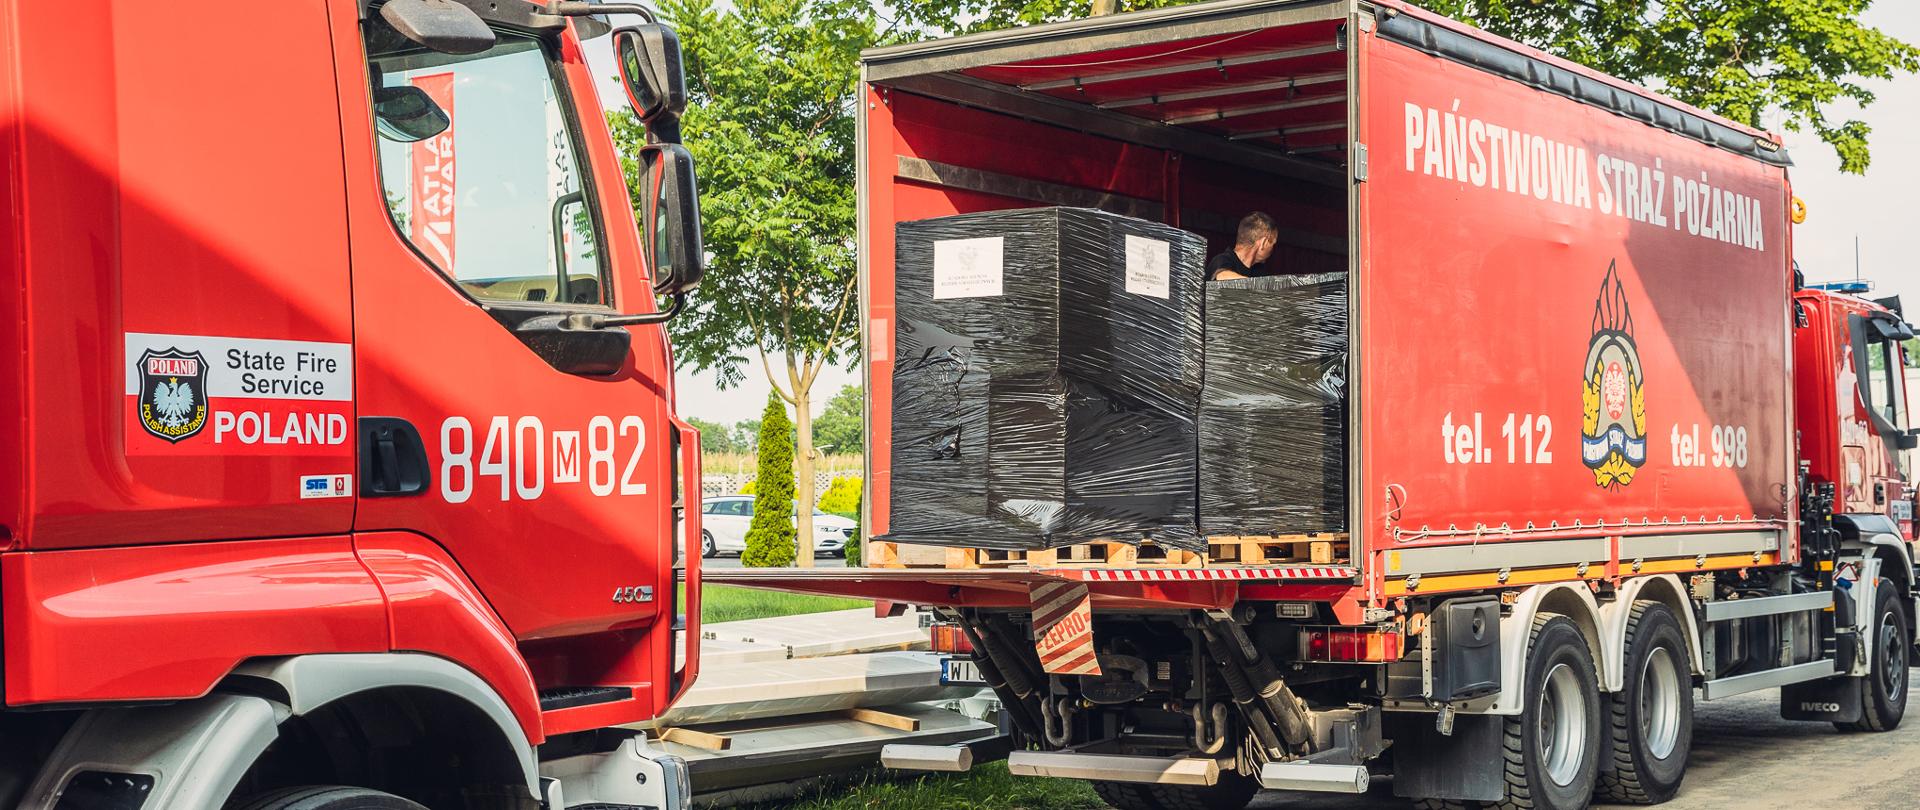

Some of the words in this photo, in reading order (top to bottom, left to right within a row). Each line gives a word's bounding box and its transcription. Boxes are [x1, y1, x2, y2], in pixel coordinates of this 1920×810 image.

[423, 137, 440, 216] ATLA
[1405, 98, 1592, 209] PAŃSTWOWA
[1597, 154, 1667, 227] STRAŻ
[1672, 171, 1764, 252] POŻARNA
[150, 359, 195, 375] POLAND
[226, 348, 285, 371] State
[297, 352, 337, 373] Fire
[241, 373, 324, 396] Service
[143, 403, 163, 432] POLISH
[163, 405, 205, 435] ASSISTANCE
[214, 411, 347, 445] POLAND
[1442, 411, 1491, 464] tel.
[1501, 412, 1553, 464] 112
[1670, 422, 1705, 467] tel.
[1711, 424, 1748, 469] 998
[1038, 611, 1086, 650] ZEPRO
[1801, 702, 1840, 711] IVECO
